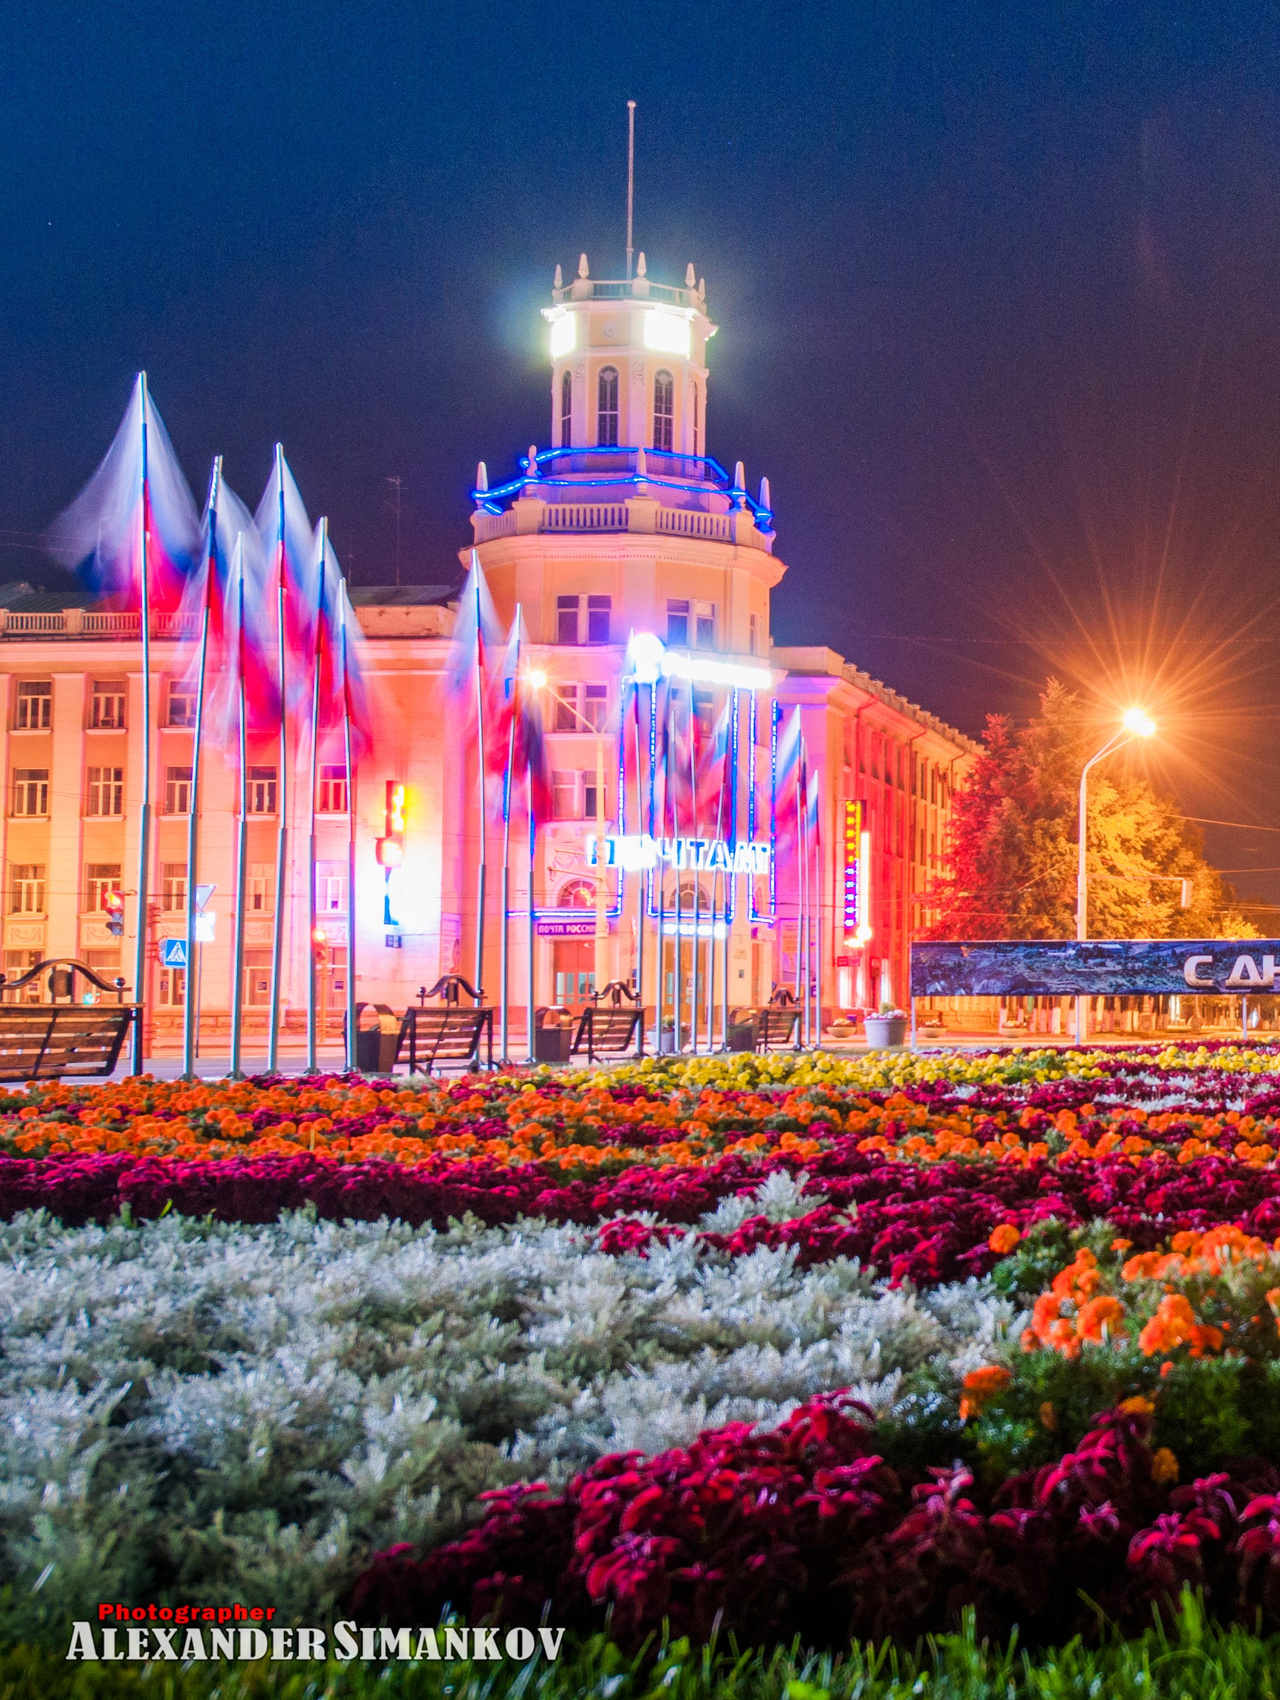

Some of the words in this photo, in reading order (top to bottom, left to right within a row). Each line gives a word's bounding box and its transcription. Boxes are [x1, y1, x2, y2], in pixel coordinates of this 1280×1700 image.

[586, 834, 771, 874] ПЧТАМТ
[538, 924, 564, 934] ПОЧТА
[1183, 954, 1214, 987] С
